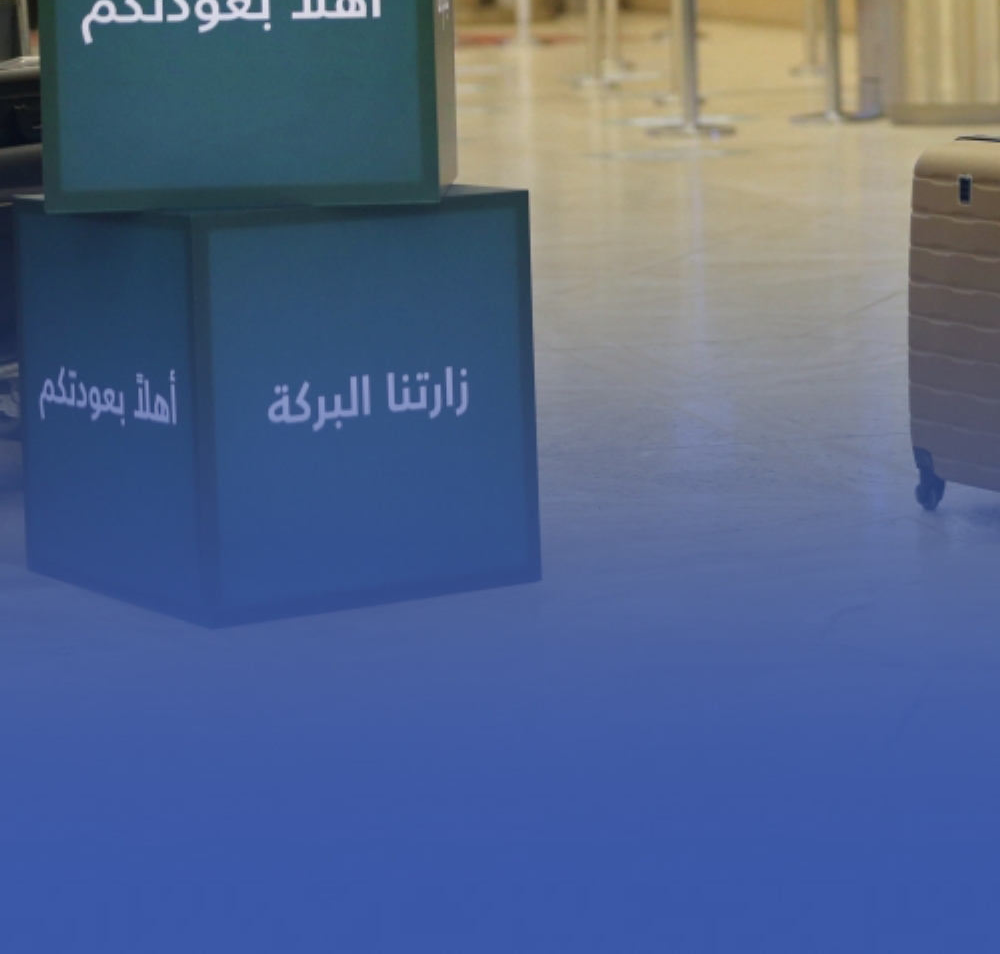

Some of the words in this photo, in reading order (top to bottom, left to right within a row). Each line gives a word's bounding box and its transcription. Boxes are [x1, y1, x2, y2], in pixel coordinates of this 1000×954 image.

[39, 366, 126, 426] بعودتكم
[267, 374, 371, 432] البركة
[386, 366, 469, 419] زارتنا
